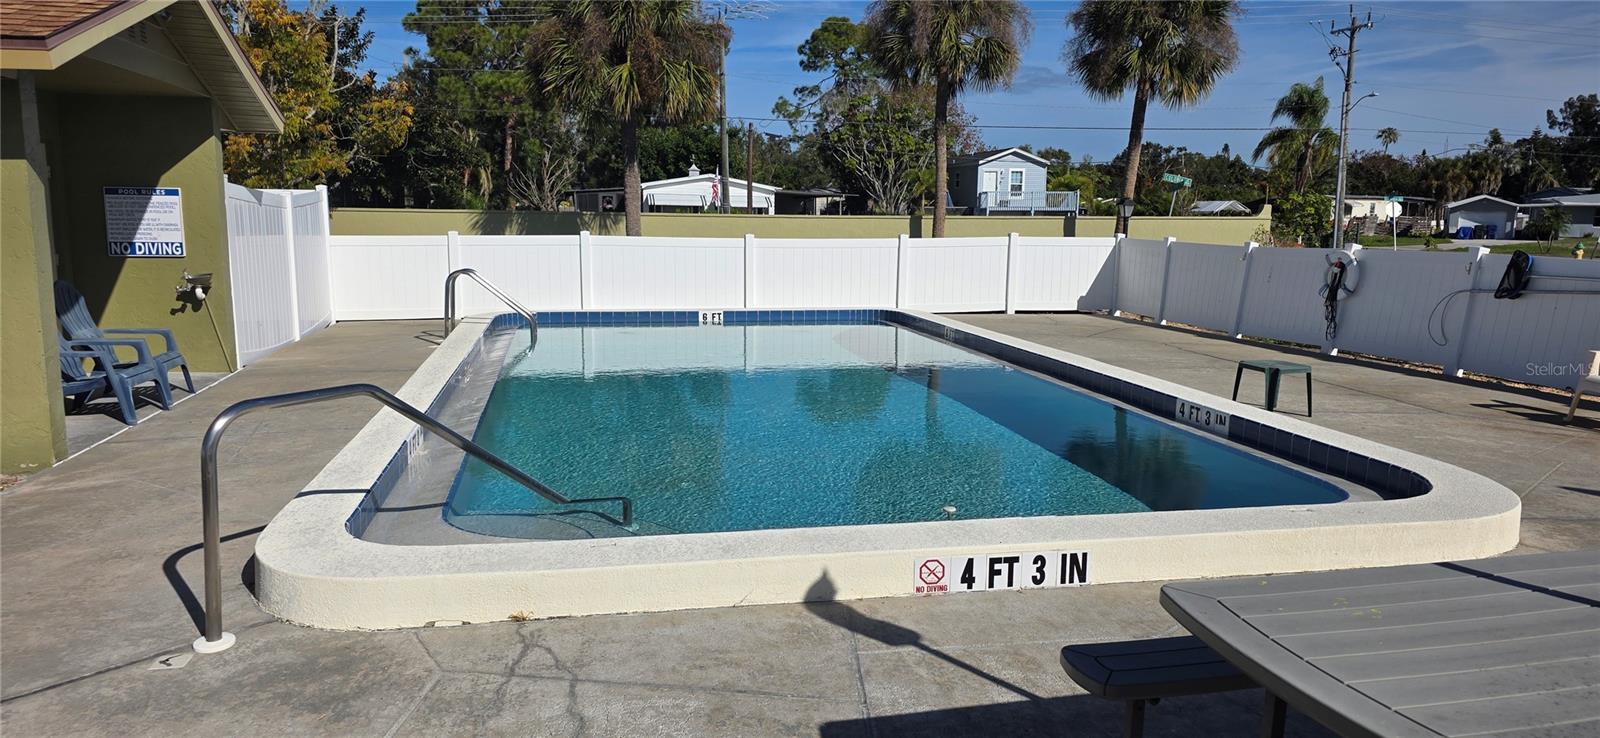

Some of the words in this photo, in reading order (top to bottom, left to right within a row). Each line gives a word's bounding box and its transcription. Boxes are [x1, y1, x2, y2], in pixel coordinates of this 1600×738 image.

[111, 242, 131, 255] NO
[135, 242, 182, 255] DIVING
[702, 312, 708, 321] 6
[711, 312, 722, 321] FT
[1179, 402, 1185, 418] 4
[1189, 404, 1201, 423] FT
[1204, 410, 1211, 426] 3
[1215, 413, 1227, 427] IN
[960, 557, 976, 590] 4
[987, 555, 1020, 589] FT
[1031, 554, 1047, 586] 3
[1060, 552, 1088, 585] IN
[926, 584, 948, 593] DIVING
